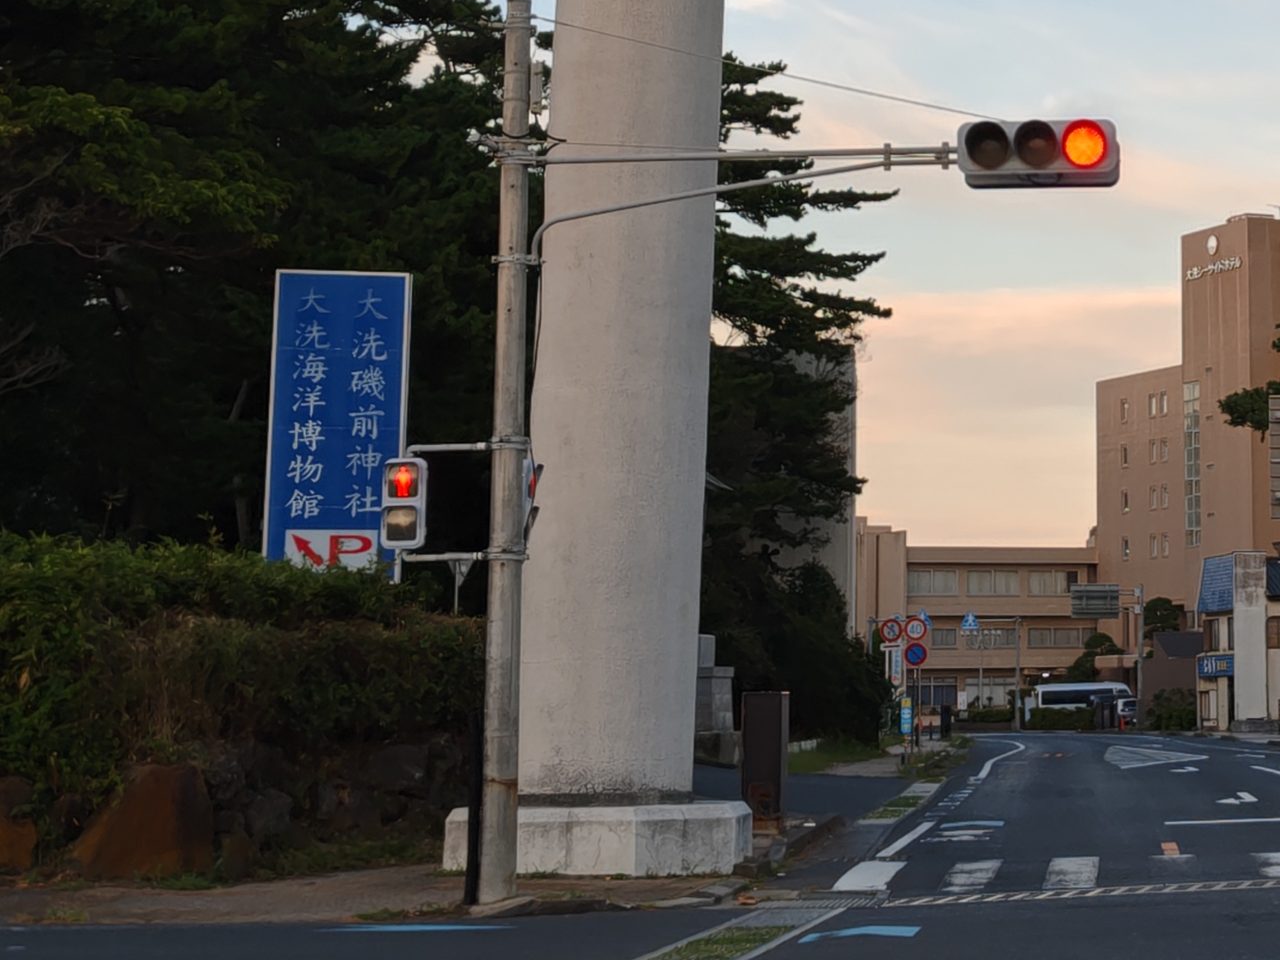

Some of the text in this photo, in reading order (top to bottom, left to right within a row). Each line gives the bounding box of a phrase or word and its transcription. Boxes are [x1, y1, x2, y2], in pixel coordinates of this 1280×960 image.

[285, 287, 330, 519] 大洗海洋博物館
[344, 288, 388, 517] 大洗磯前神社
[329, 535, 373, 566] P
[909, 623, 922, 635] 40
